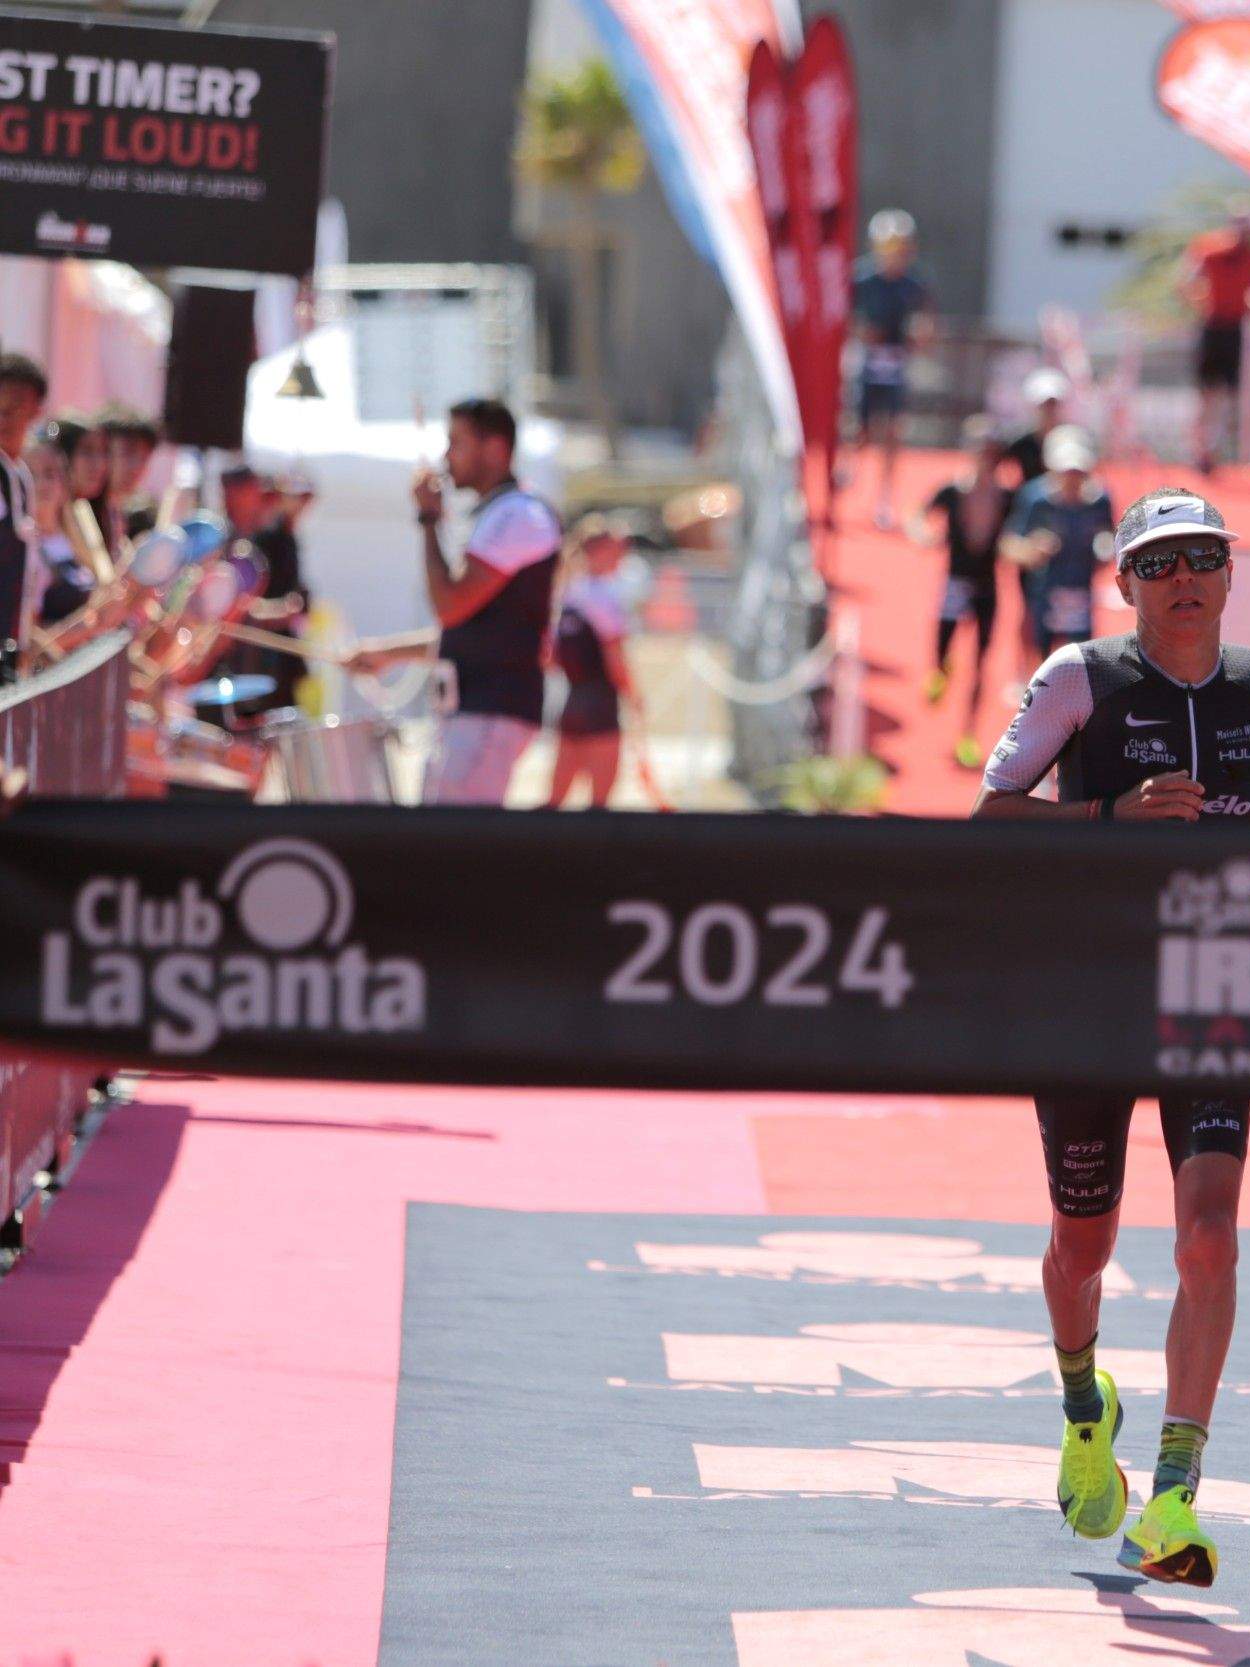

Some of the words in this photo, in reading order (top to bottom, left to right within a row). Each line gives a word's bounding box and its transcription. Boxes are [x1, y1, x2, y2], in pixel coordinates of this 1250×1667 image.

[65, 54, 262, 118] TIMER?
[43, 109, 92, 157] IT
[102, 113, 261, 172] LOUD!
[1129, 739, 1149, 749] Club
[1202, 795, 1250, 816] élo
[74, 875, 223, 948] Club
[605, 902, 914, 1008] 2024
[1193, 1118, 1240, 1133] HUUB
[1061, 1184, 1109, 1197] HUUB
